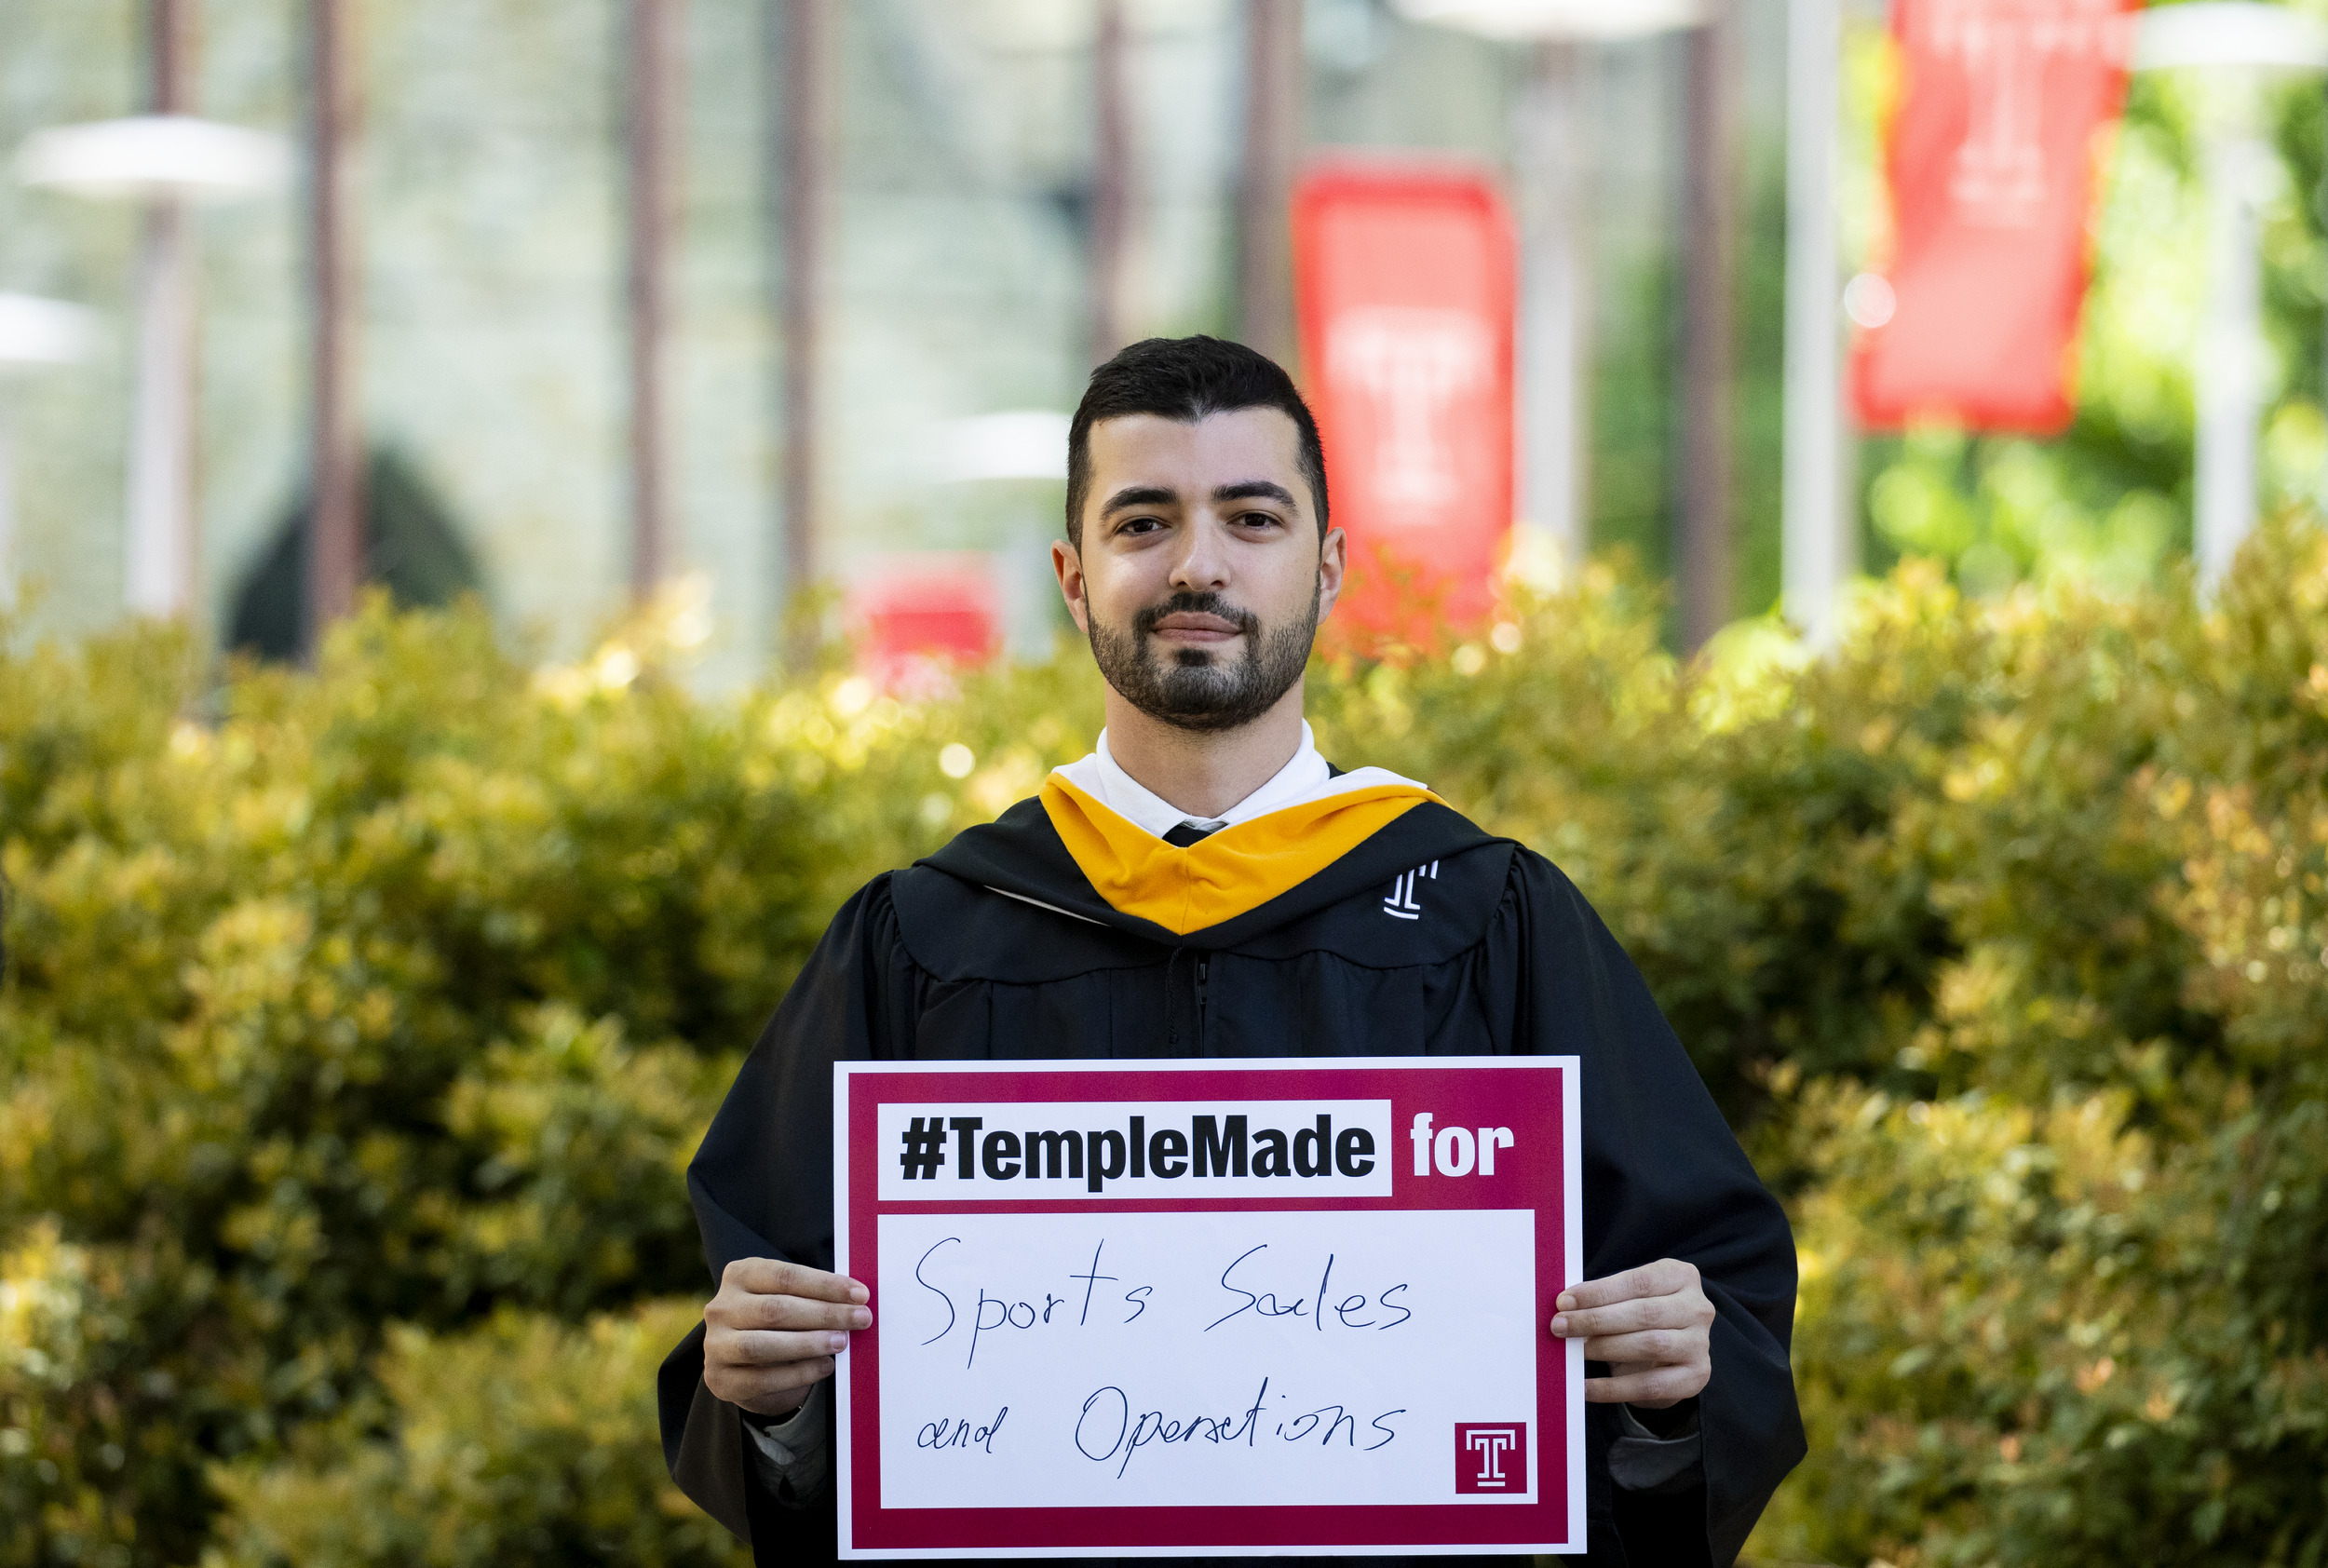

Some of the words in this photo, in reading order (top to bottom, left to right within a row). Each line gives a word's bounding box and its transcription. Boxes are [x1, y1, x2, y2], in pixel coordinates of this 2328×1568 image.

[900, 1114, 1376, 1193] #TempleMade
[1410, 1112, 1515, 1177] for
[914, 1237, 1154, 1370] Sports
[1203, 1243, 1414, 1331] Sales
[916, 1406, 1009, 1454] and
[1074, 1376, 1407, 1480] Operations
